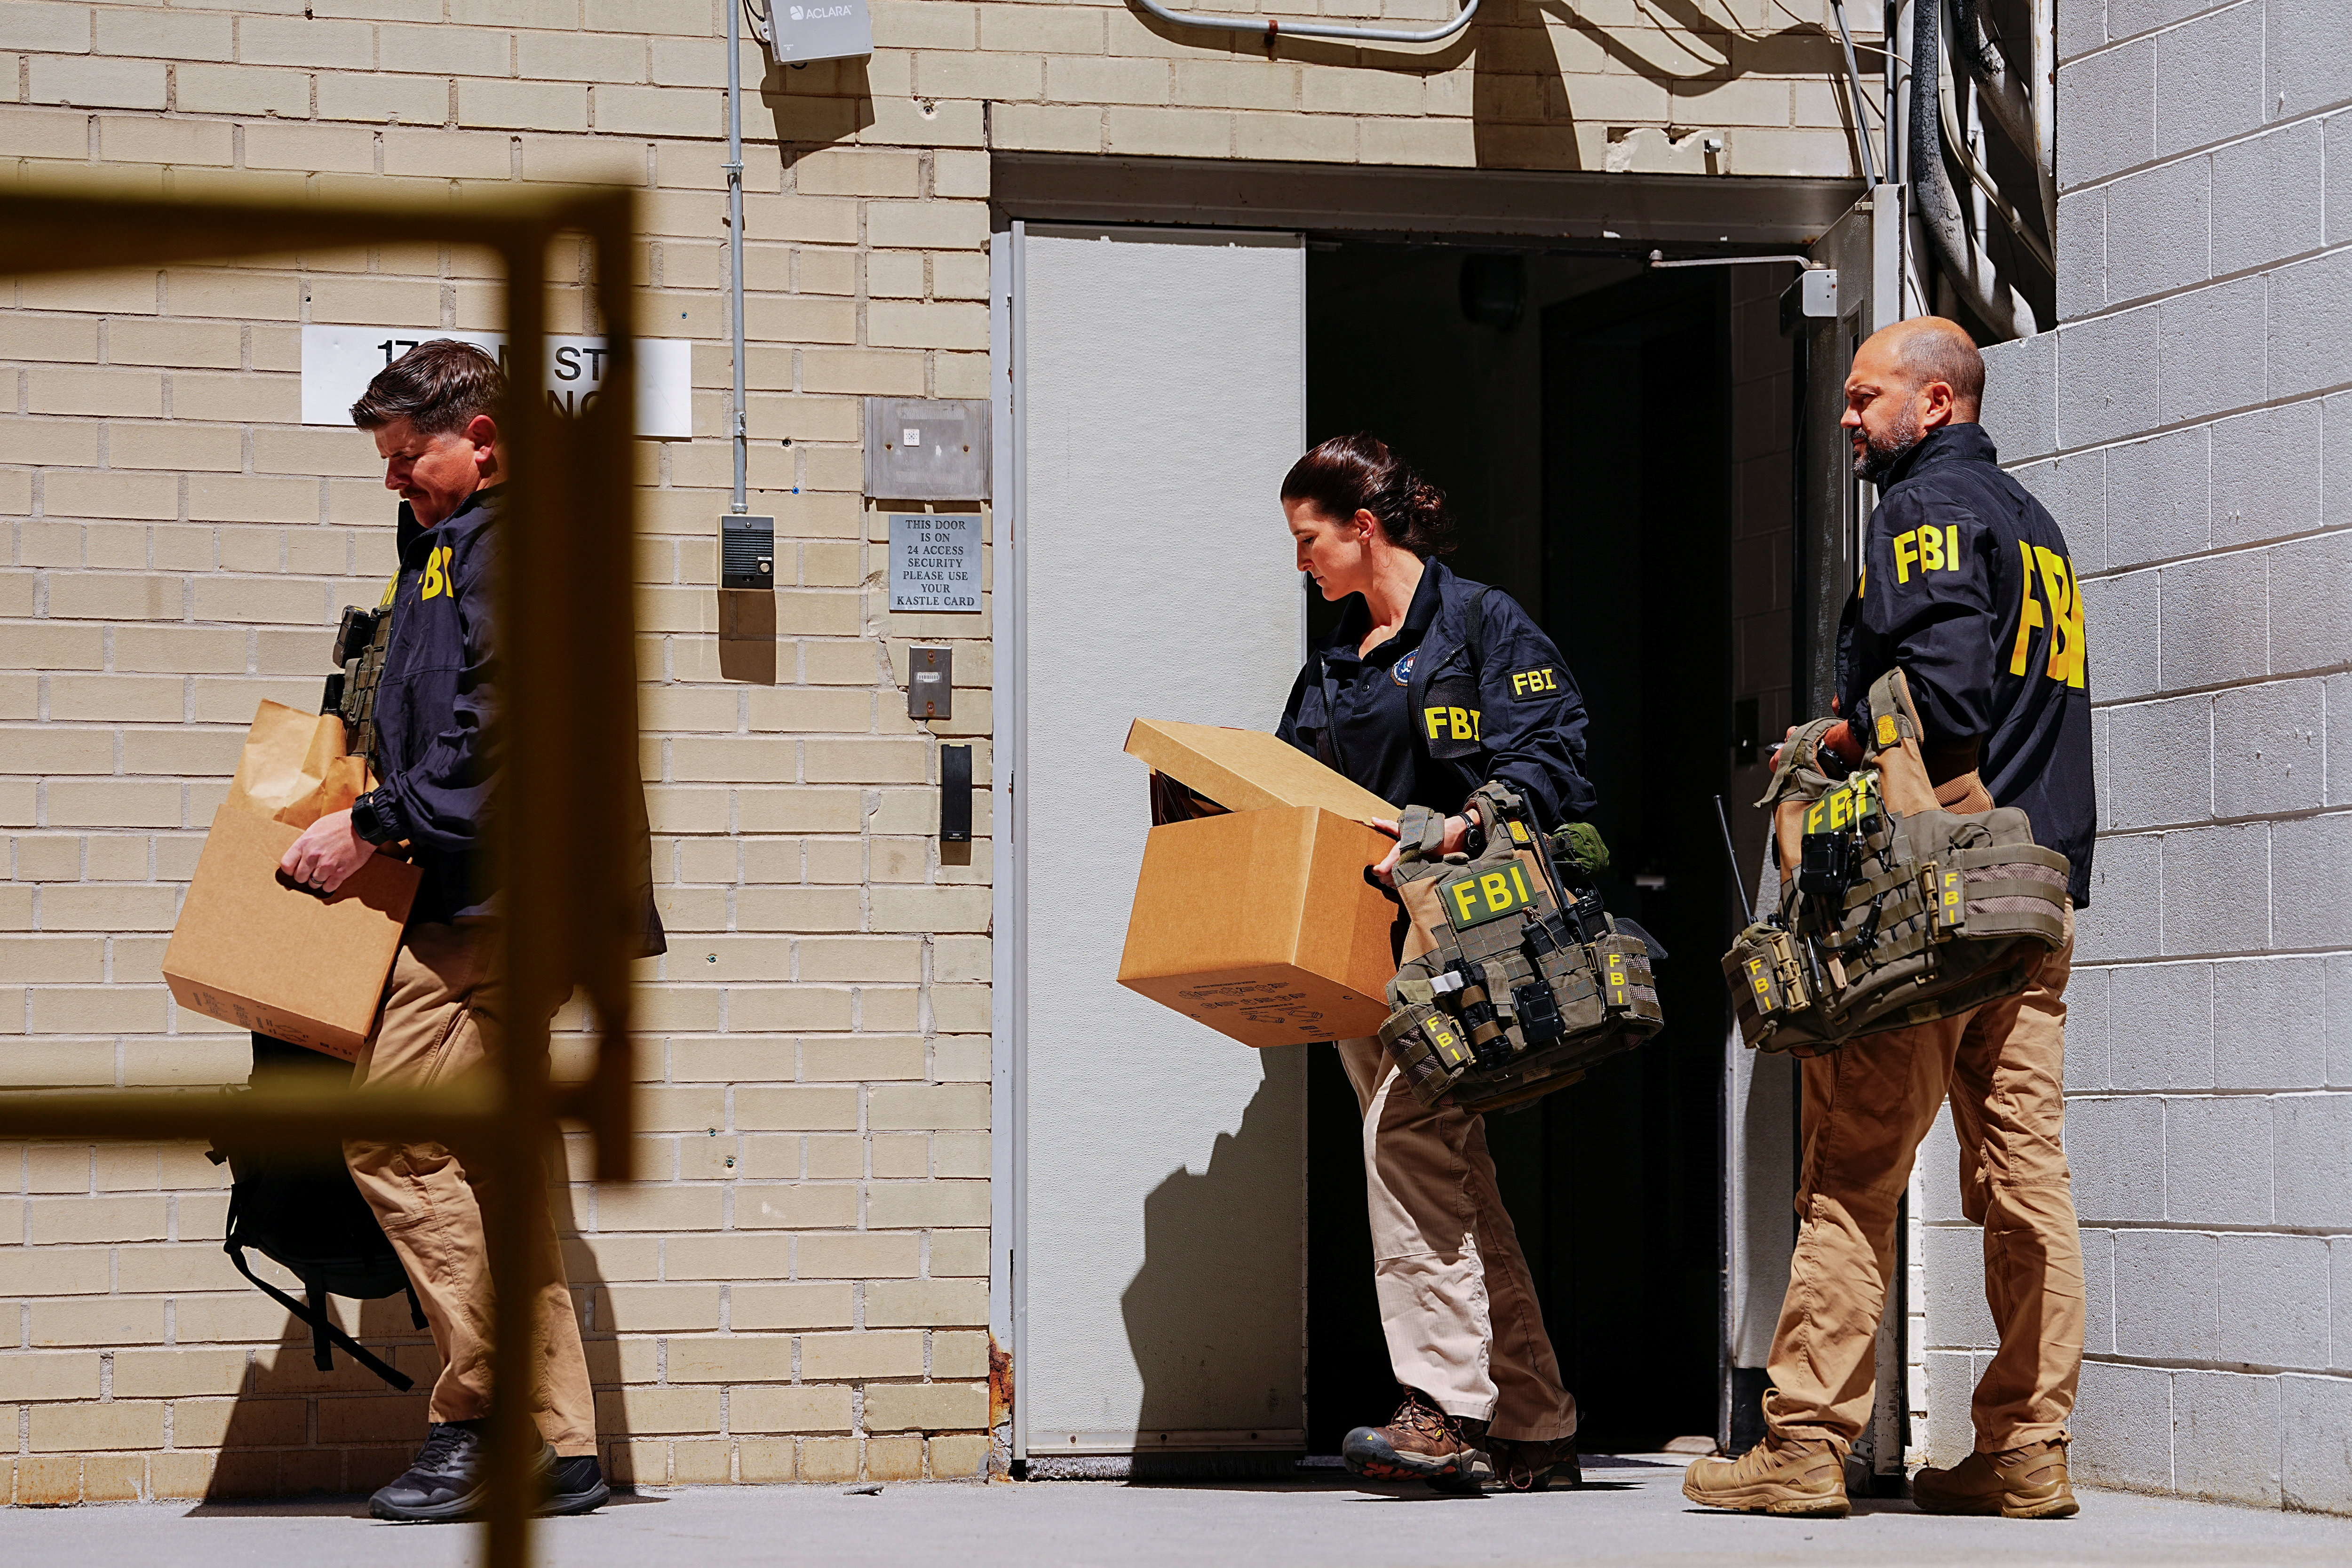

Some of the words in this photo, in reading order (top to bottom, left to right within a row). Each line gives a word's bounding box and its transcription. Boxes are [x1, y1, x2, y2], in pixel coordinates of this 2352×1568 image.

[906, 520, 930, 529] THIS
[935, 520, 966, 530] DOOR
[921, 533, 930, 542] IS
[935, 533, 950, 542] ON
[907, 546, 919, 554] 24
[922, 546, 963, 555] ACCESS
[908, 558, 963, 567] SECURITY
[1893, 525, 1959, 584] FBI
[903, 571, 944, 580] PLEASE
[948, 572, 968, 581] USE
[921, 584, 951, 593] YOUR
[897, 596, 939, 605] KASTLE
[944, 597, 975, 606] CARD
[2009, 539, 2085, 689] FBI
[1512, 669, 1557, 696] FBI
[1808, 779, 1867, 834] FBI
[1452, 866, 1529, 921] FBI
[1944, 873, 1959, 923] FBI
[1609, 954, 1625, 1003] FBI
[1749, 959, 1772, 1010] FBI
[1427, 1016, 1460, 1061] FBI
